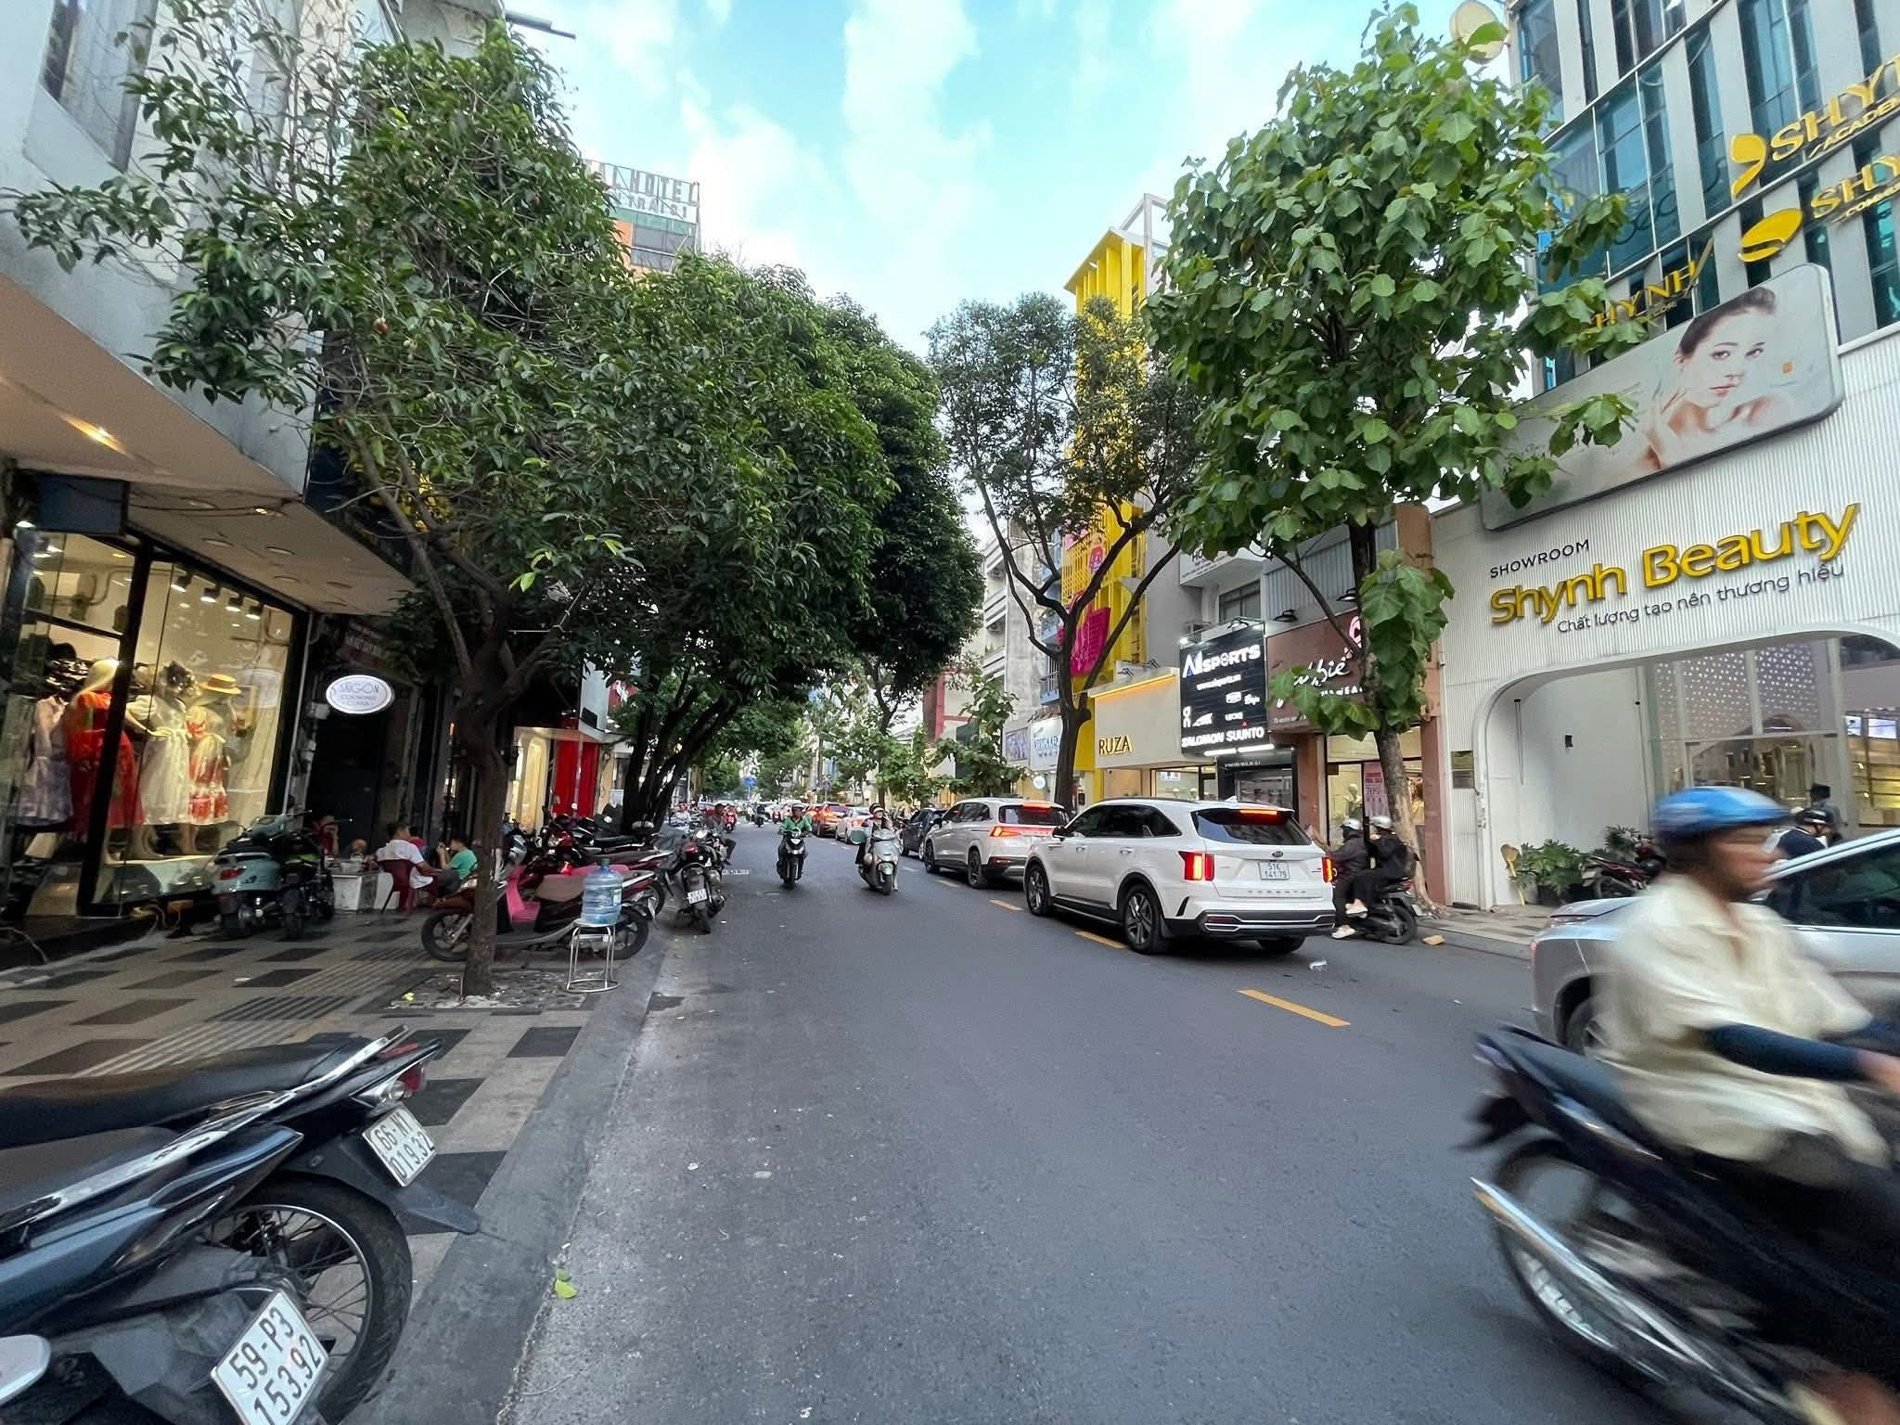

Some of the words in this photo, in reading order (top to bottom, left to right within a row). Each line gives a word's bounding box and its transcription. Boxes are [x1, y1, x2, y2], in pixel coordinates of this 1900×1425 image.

[1490, 539, 1590, 578] SHOWROOM
[1490, 563, 1627, 624] Shynh
[1642, 503, 1861, 589] Beauty
[1557, 613, 1591, 633] Chất
[1595, 608, 1639, 625] lượng
[1644, 602, 1672, 616] tạo
[1677, 591, 1712, 610] nên
[1716, 577, 1790, 601] thương
[1099, 735, 1132, 756] RUZA
[1181, 732, 1224, 748] SALOMON
[1226, 727, 1265, 742] SUUNTO
[389, 1131, 435, 1178] 019.32
[228, 1306, 294, 1390] 59-P3
[253, 1334, 321, 1425] 153.92
